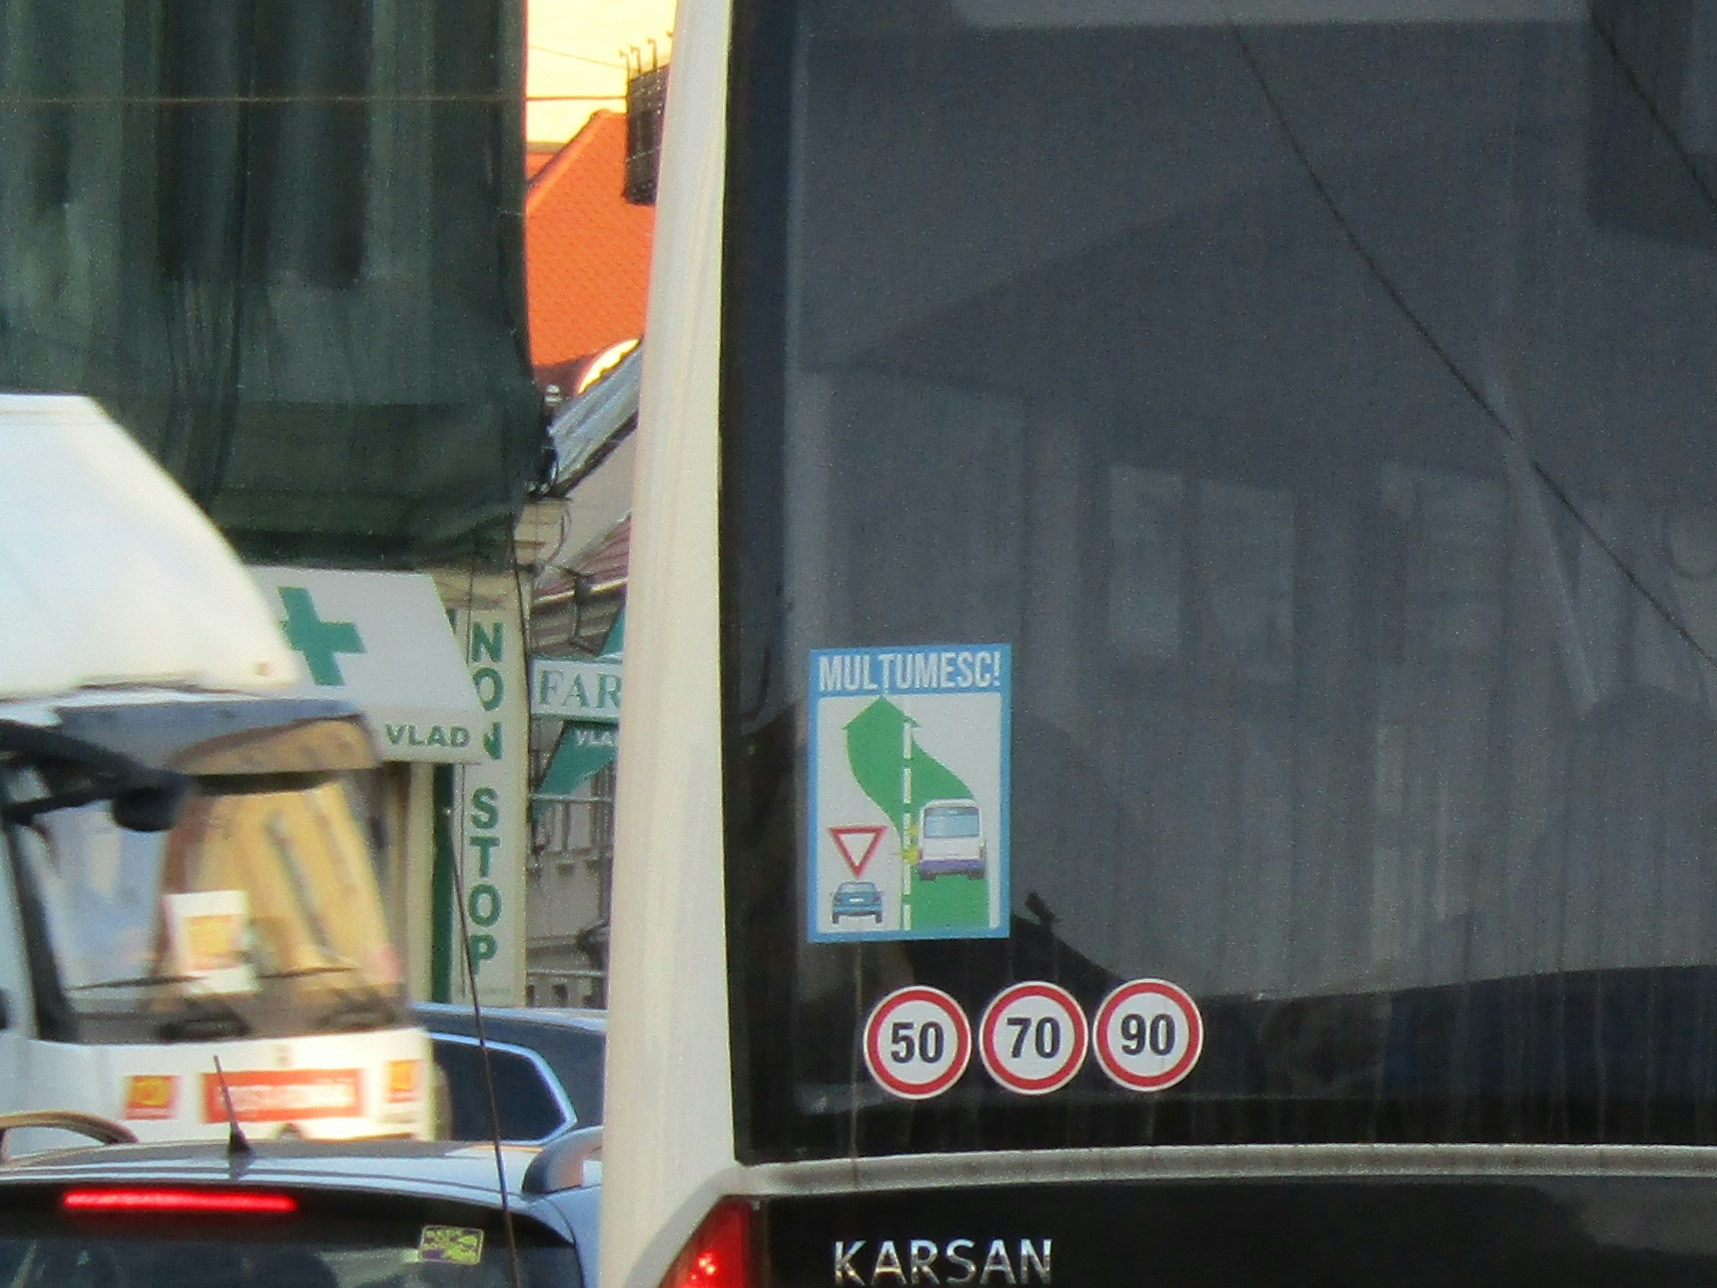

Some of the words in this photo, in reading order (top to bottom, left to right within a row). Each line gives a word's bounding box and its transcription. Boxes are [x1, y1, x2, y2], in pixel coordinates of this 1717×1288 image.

[385, 722, 473, 749] VLAD
[467, 786, 503, 976] STOP
[890, 1021, 945, 1064] 50
[1006, 1016, 1062, 1059] 70
[1120, 1013, 1177, 1056] 90
[833, 1237, 1053, 1287] KARSAN
